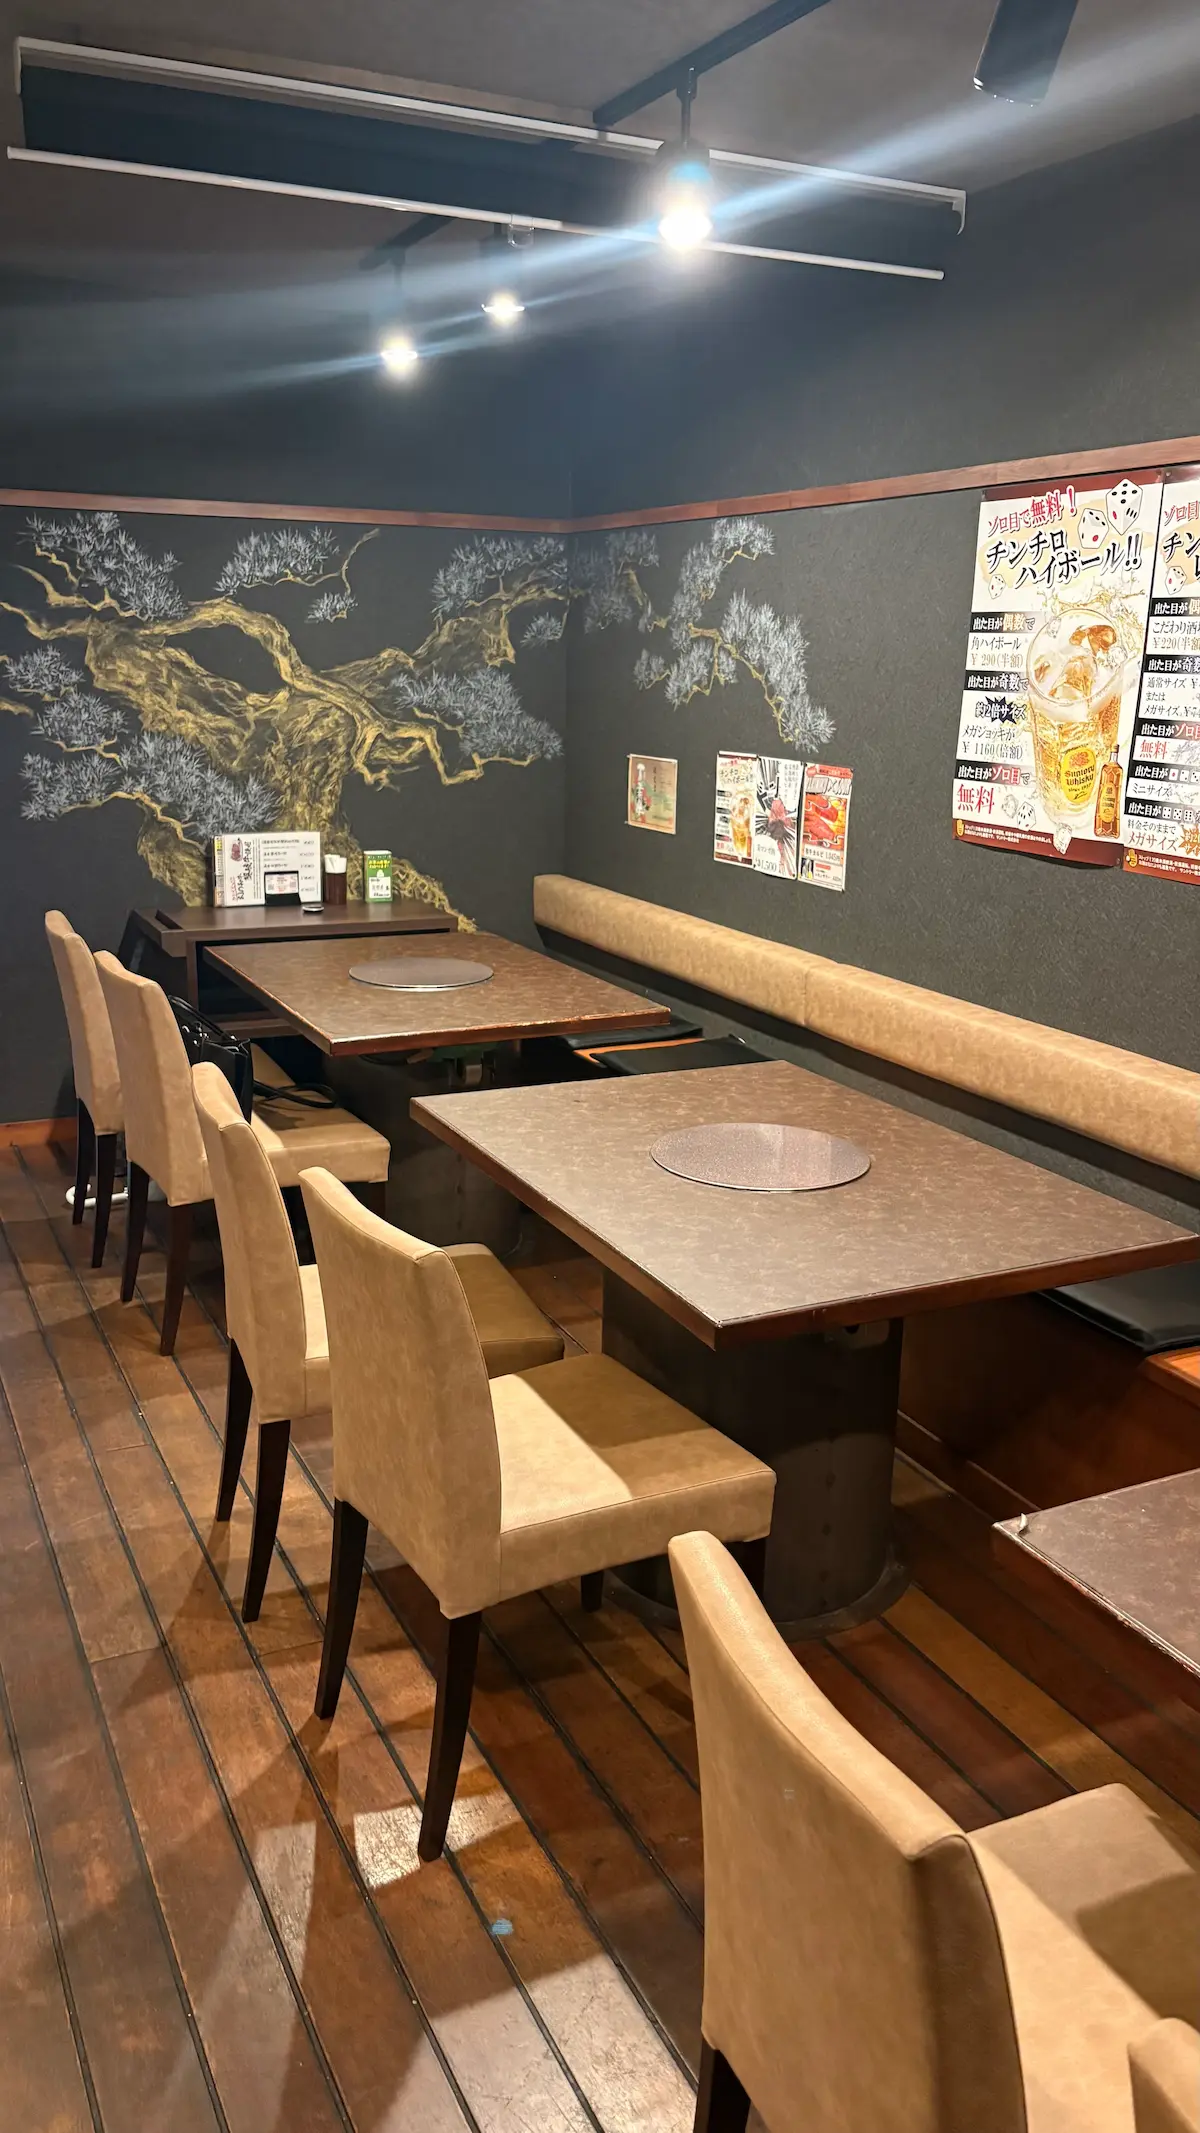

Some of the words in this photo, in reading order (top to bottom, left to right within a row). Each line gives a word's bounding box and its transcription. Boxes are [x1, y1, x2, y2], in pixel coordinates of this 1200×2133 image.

[986, 529, 1065, 574] チンチロ
[973, 613, 1035, 631] 出た目が偶数で
[971, 636, 1022, 650] 角ハイボール
[967, 673, 1029, 691] 出た目が奇数で
[1145, 691, 1166, 702] または
[975, 701, 1028, 720] 約2倍サイズ
[962, 724, 1016, 741] メガジョッキが
[1139, 740, 1168, 760] 無料
[957, 764, 1030, 785] 出た目がゾロ目で
[1134, 764, 1168, 779] 出た目が
[957, 783, 995, 815] 無料
[1131, 782, 1173, 798] ミニサイズ
[1128, 801, 1162, 817] 出た目が
[1128, 831, 1179, 852] メガサイズ
